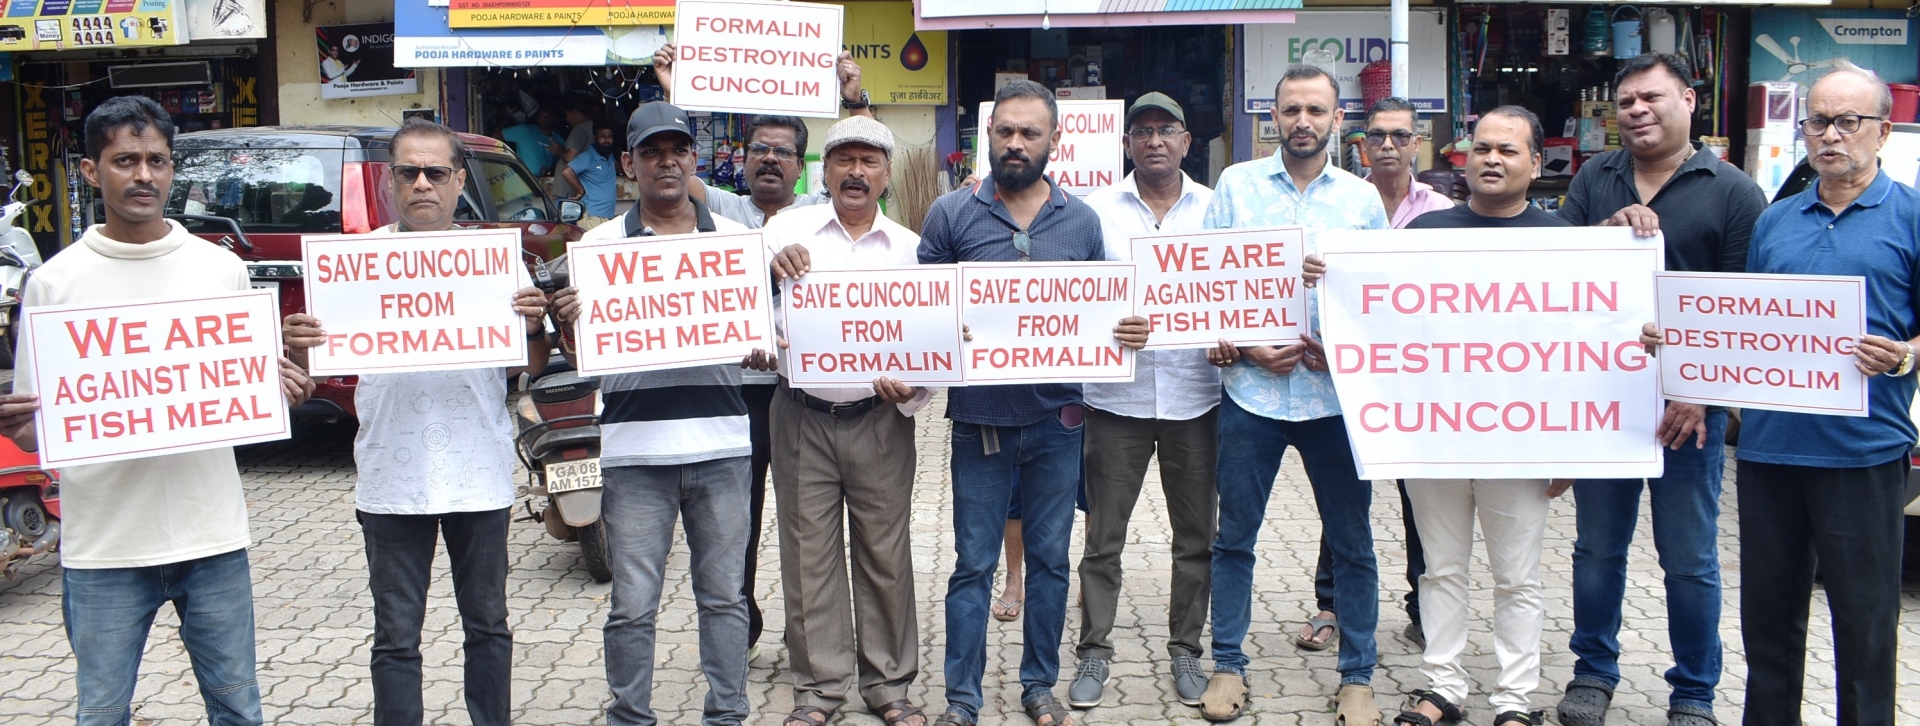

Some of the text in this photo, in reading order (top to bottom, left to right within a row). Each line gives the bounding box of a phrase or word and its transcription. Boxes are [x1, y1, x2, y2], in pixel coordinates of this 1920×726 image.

[470, 13, 498, 21] POOJA
[499, 12, 545, 21] HARDWARE
[554, 12, 582, 20] PAINTS
[637, 11, 676, 19] HARDWA
[695, 17, 821, 39] FORMALIN
[1834, 25, 1902, 39] Crompton
[415, 50, 564, 59] POOJA HARDWARE & PAINTS
[681, 45, 834, 69] DESTROYING
[691, 75, 820, 97] CUNCOLIM
[1057, 113, 1115, 136] NCOLIM
[317, 247, 509, 284] SAVE CUNCOLIM
[598, 248, 746, 286] WE ARE
[1152, 242, 1285, 273] WE ARE
[792, 280, 950, 309] SAVE CUNCOLIM
[969, 277, 1128, 304] SAVE CUNCOLIM
[1143, 277, 1296, 305] AGAINST NEW
[1361, 281, 1618, 315] FORMALIN
[380, 291, 455, 319] FROM
[589, 286, 758, 324] AGAINST NEW
[1678, 294, 1836, 319] FORMALIN
[841, 319, 903, 343] FROM
[1017, 314, 1079, 337] FROM
[1149, 308, 1297, 333] FISH MEAL
[64, 311, 253, 359] WE ARE
[327, 325, 511, 357] FORMALIN
[595, 320, 762, 355] FISH MEAL
[1664, 328, 1854, 356] DESTROYING
[801, 351, 953, 373] FORMALIN
[971, 346, 1124, 369] FORMALIN
[1334, 340, 1649, 374] DESTROYING
[54, 355, 268, 406] AGAINST NEW
[545, 385, 576, 394] HONDA
[1678, 362, 1840, 391] CUNCOLIM
[63, 394, 272, 443] FISH MEAL
[1359, 401, 1621, 433] CUNCOLIM
